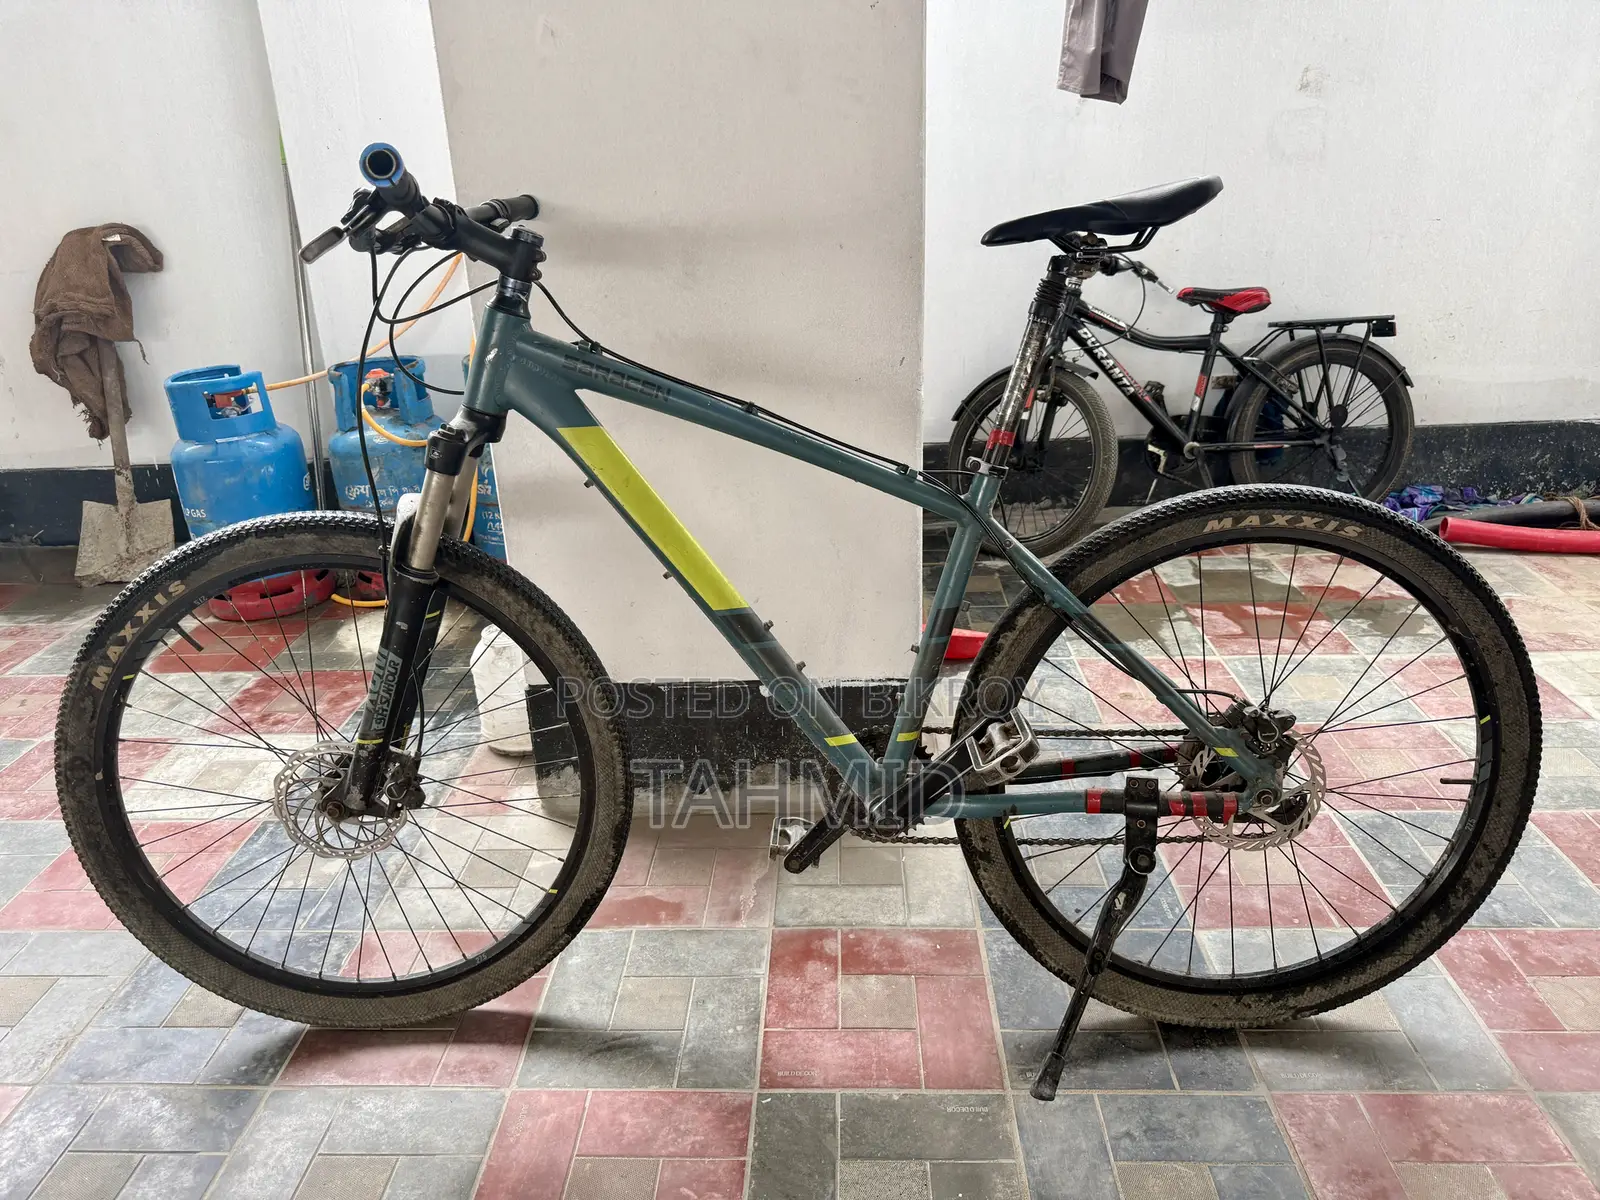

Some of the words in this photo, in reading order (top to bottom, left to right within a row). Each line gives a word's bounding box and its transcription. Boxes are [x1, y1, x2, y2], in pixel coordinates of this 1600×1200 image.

[1078, 327, 1135, 396] DURANTA
[190, 508, 207, 518] GAS
[1202, 514, 1363, 538] MAXXIS
[91, 580, 186, 690] MAXXIS
